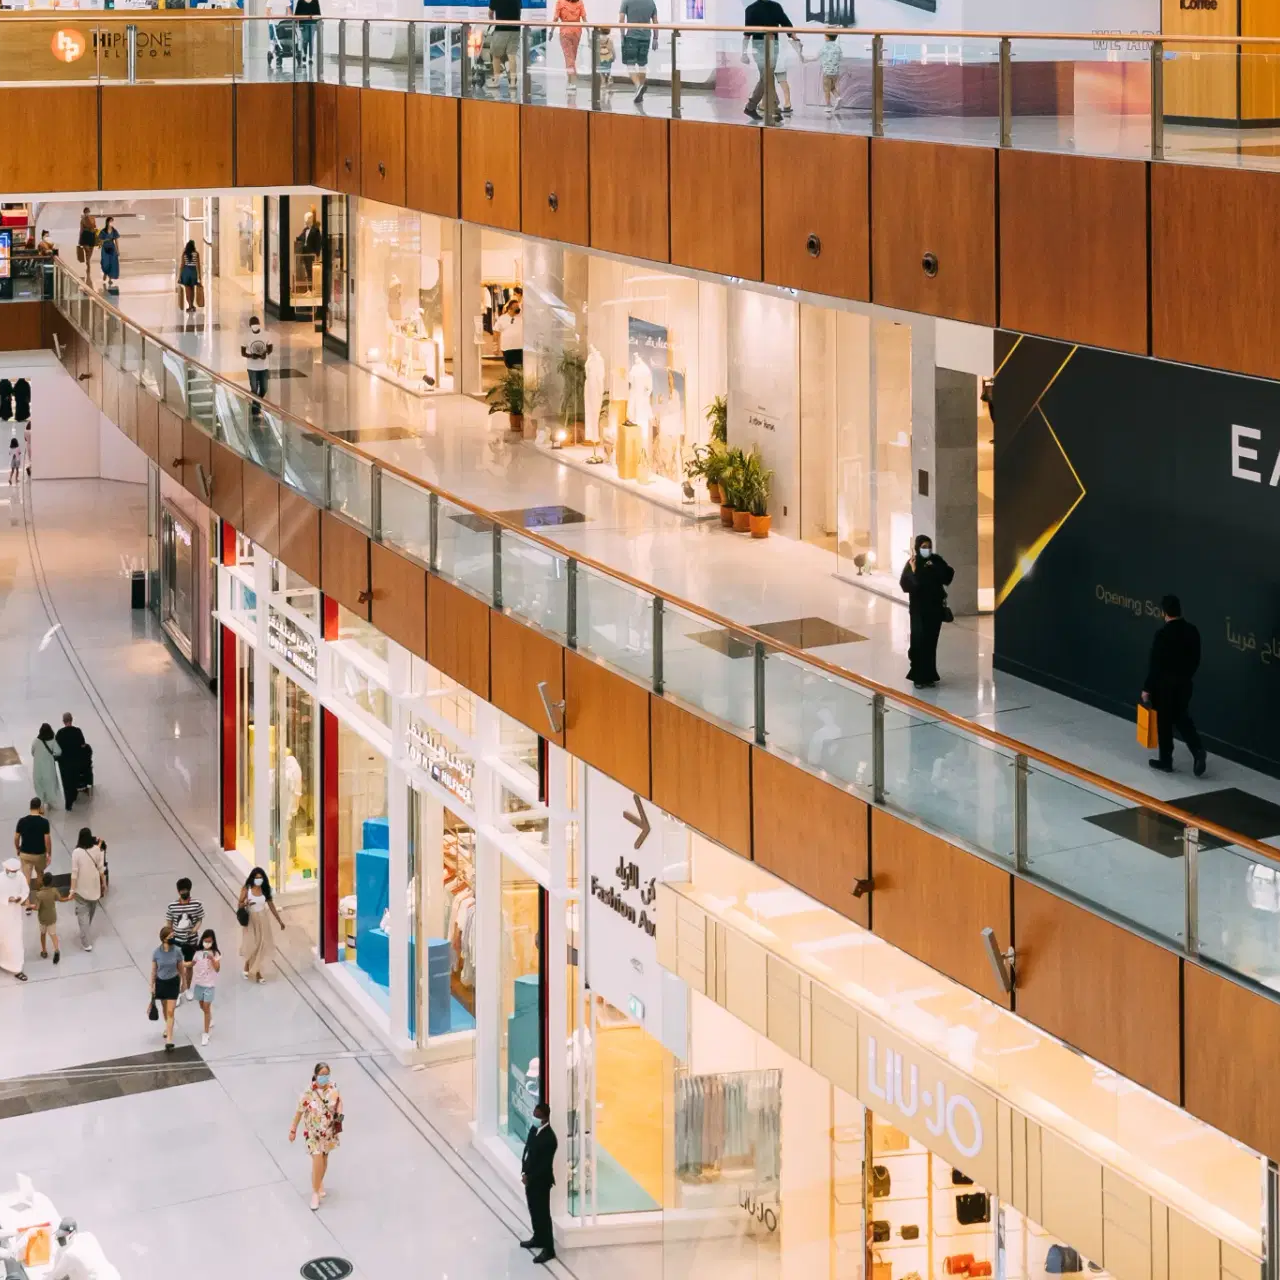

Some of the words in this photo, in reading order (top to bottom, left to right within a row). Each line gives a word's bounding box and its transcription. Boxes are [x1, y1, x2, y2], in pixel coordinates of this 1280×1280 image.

[93, 49, 172, 58] TELCOM
[1095, 584, 1142, 617] Opening
[441, 769, 473, 804] HILFIGER
[590, 875, 636, 924] Fashion
